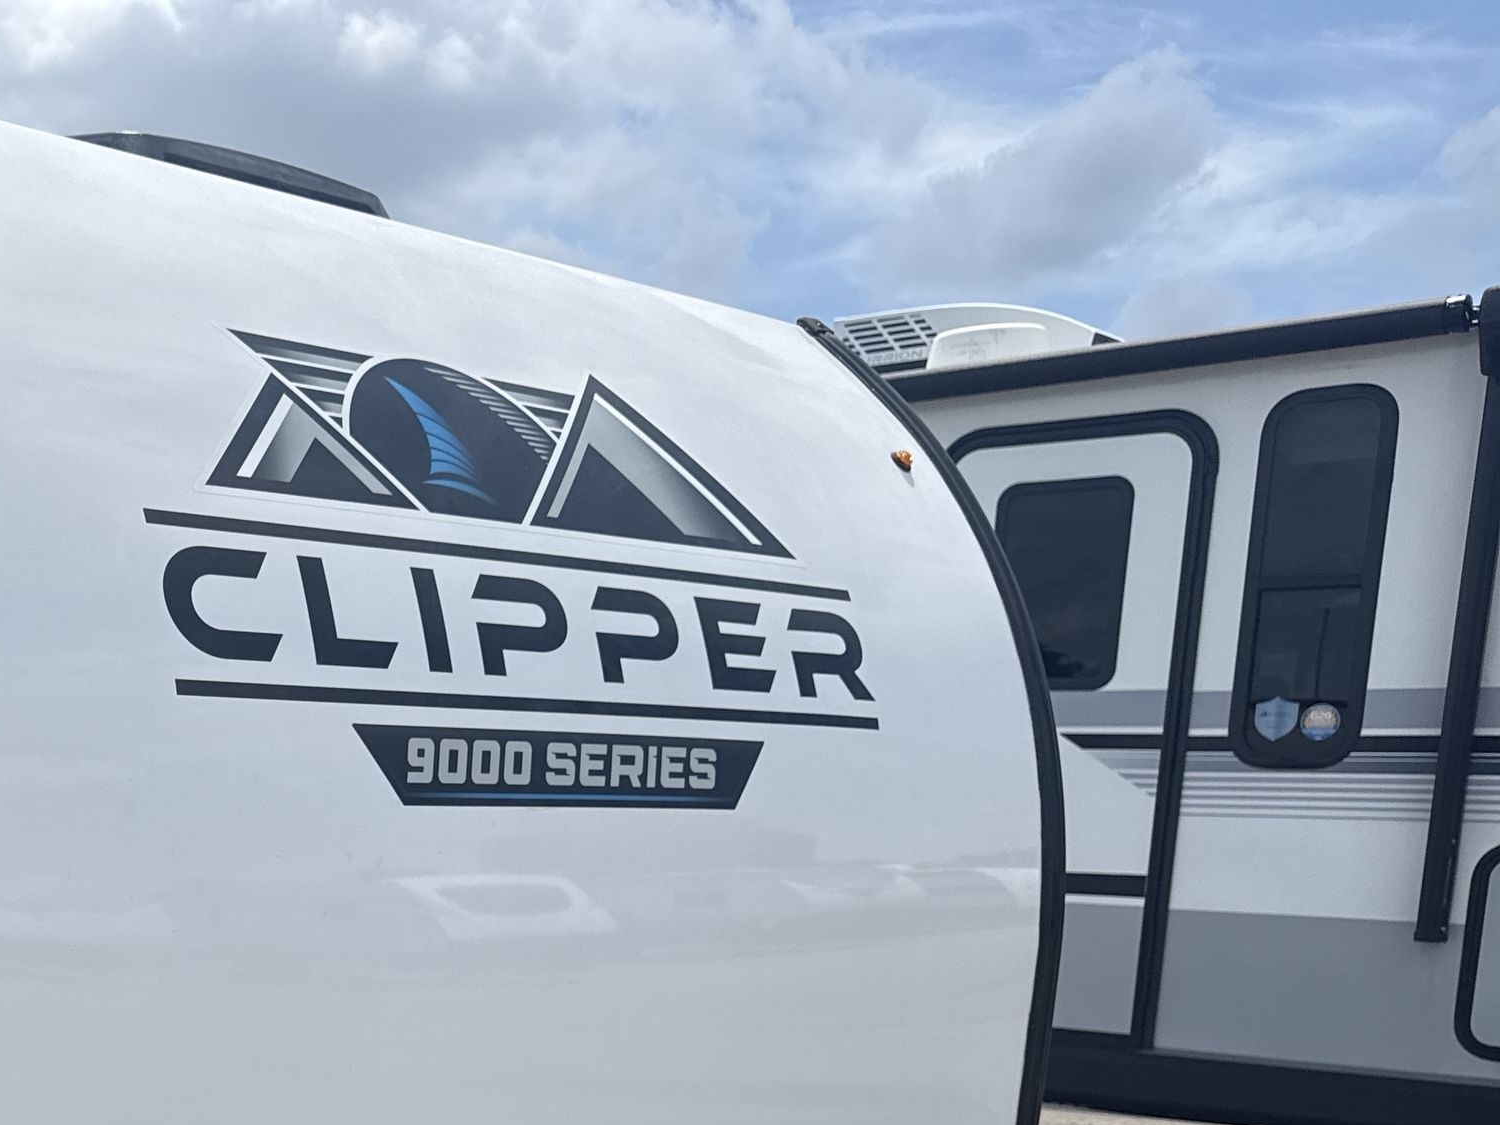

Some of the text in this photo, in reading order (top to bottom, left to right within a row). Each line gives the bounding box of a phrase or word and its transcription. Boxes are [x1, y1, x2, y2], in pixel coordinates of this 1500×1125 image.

[162, 545, 876, 702] CLIPPER
[406, 737, 718, 790] 9000 SERIES
